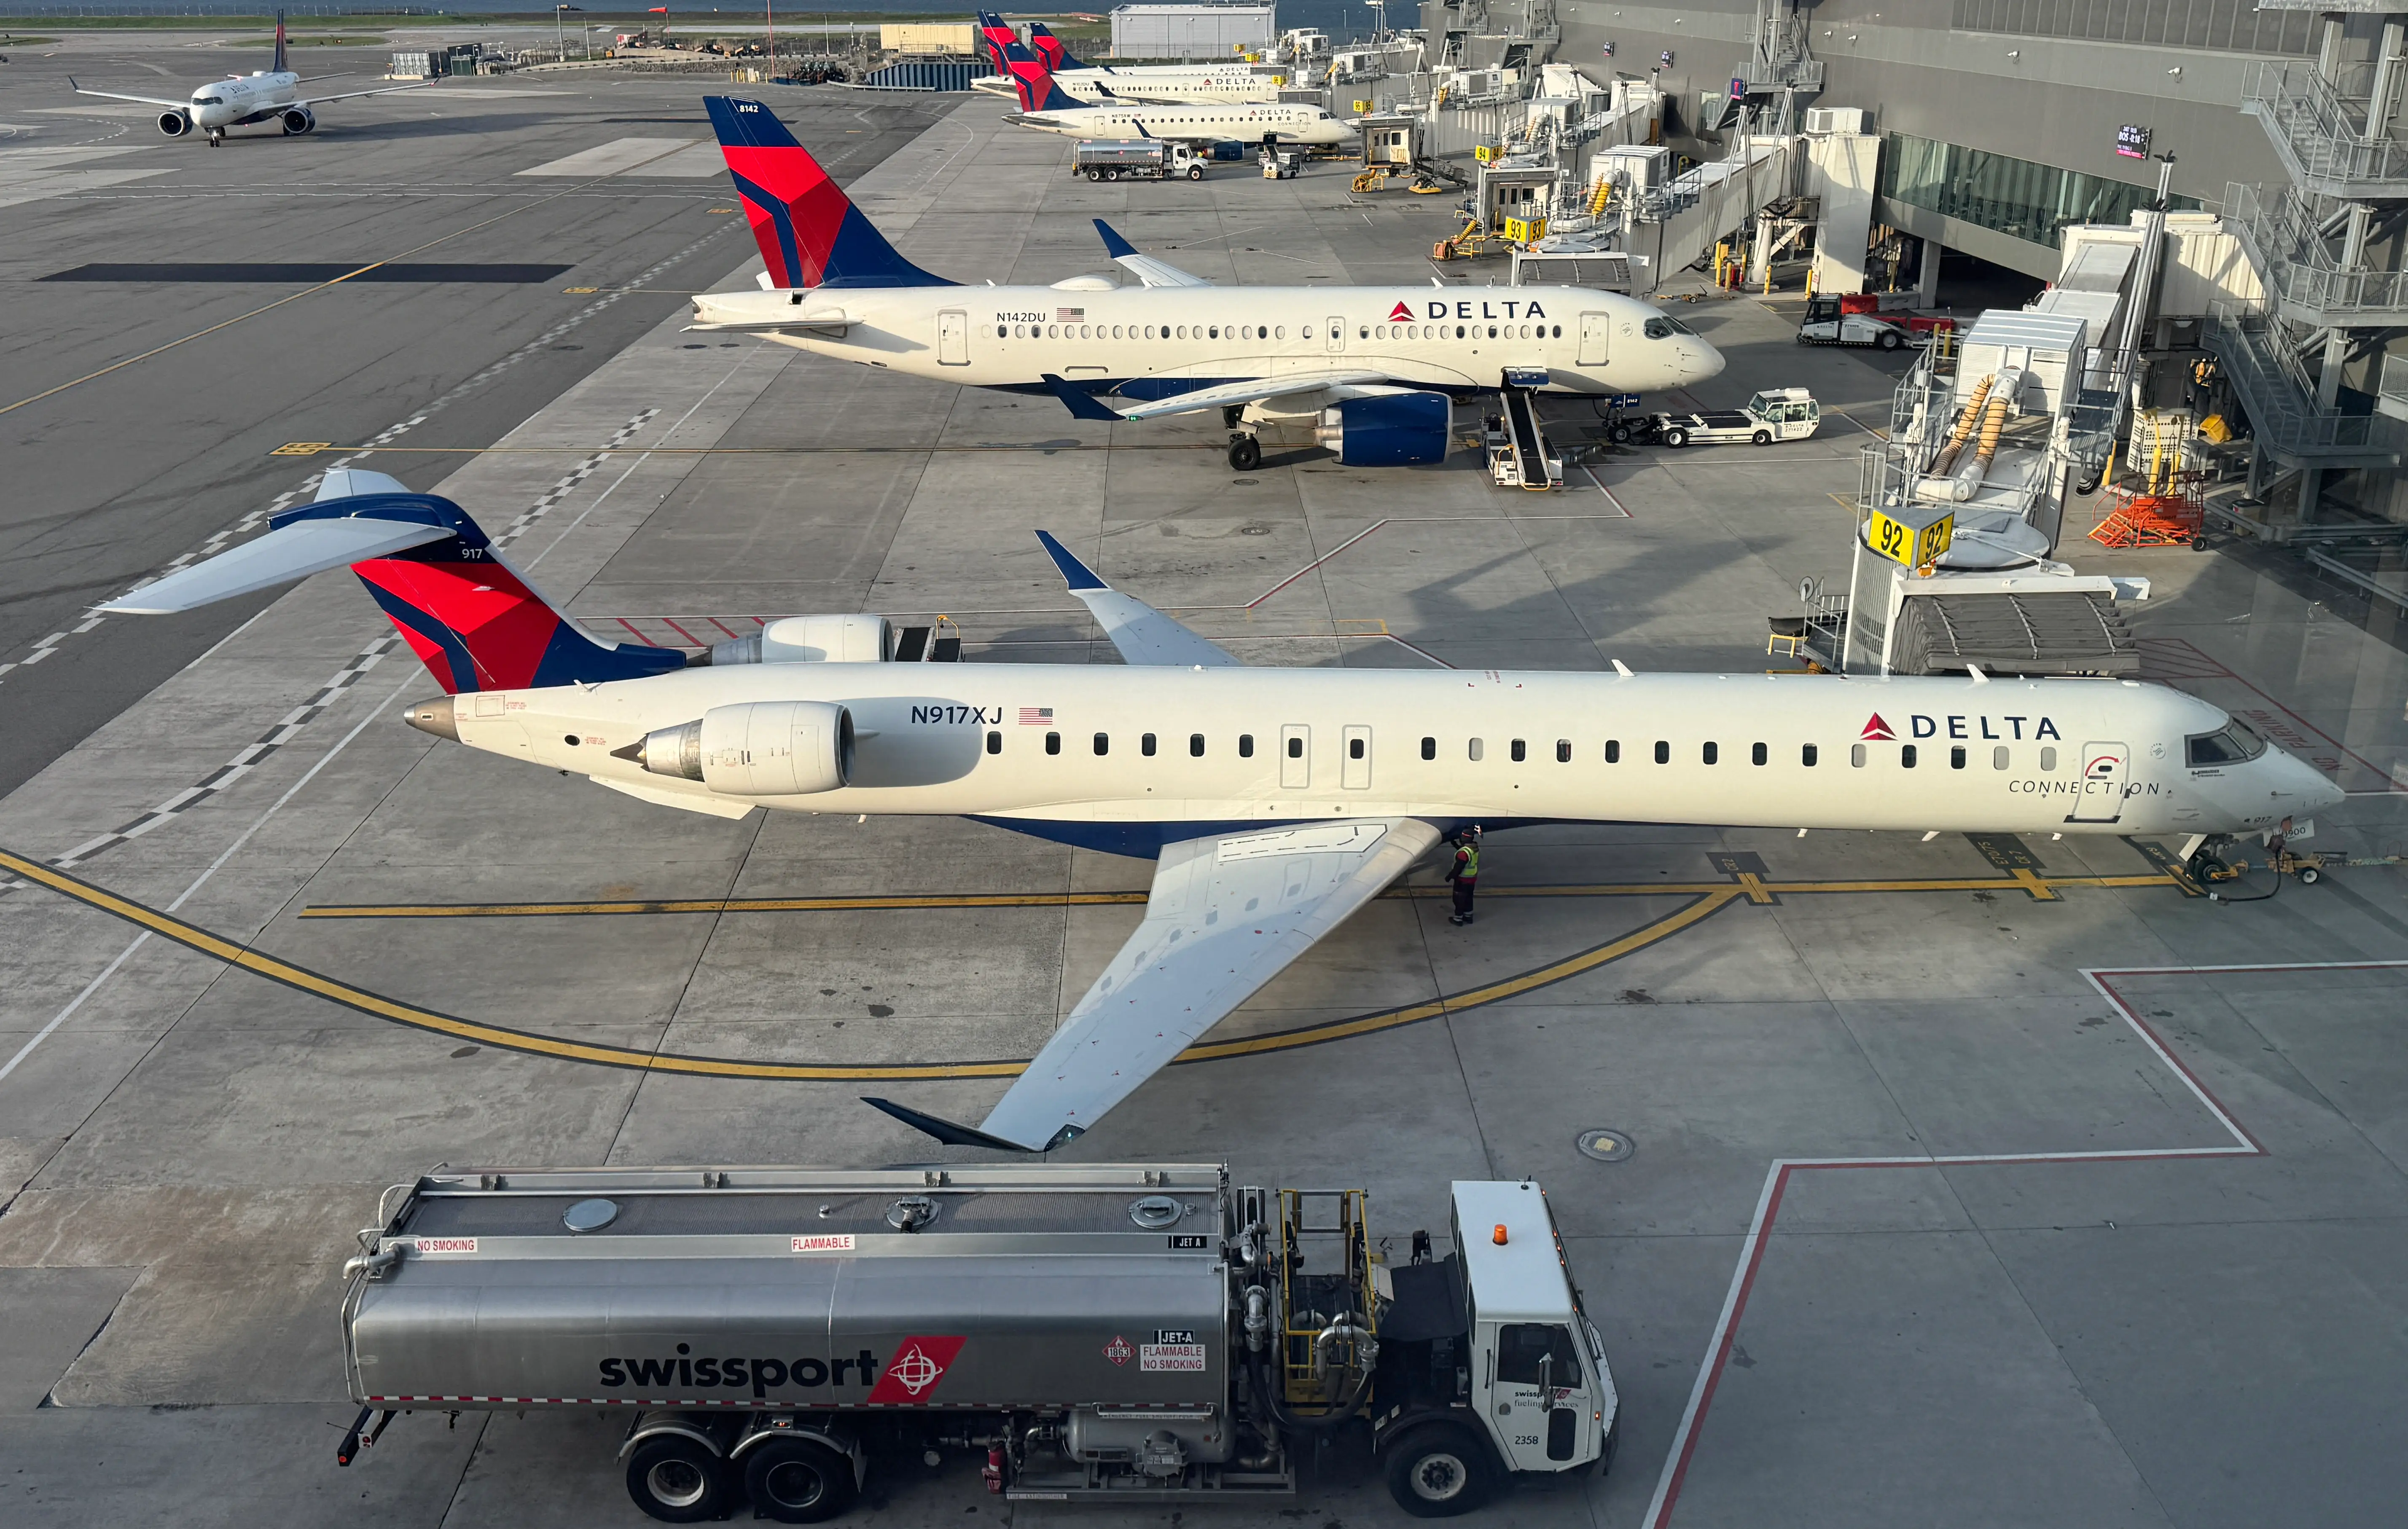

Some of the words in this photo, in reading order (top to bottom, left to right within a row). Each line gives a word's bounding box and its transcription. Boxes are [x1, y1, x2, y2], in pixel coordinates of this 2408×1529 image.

[2118, 131, 2129, 142] BOS
[1479, 148, 1486, 160] 94
[1493, 147, 1499, 160] 94
[1511, 220, 1521, 239] 93
[1533, 220, 1541, 240] 93
[1428, 301, 1546, 319] DELTA
[997, 312, 1045, 322] N142DU
[1881, 519, 1903, 558] 92
[1925, 523, 1943, 559] 92
[462, 549, 482, 558] 917
[911, 706, 1002, 724] N917XJ
[1911, 714, 2061, 740] DELTA
[2009, 780, 2161, 794] CONNECTION
[417, 1241, 430, 1251] NO
[433, 1240, 474, 1251] SMOKING
[793, 1237, 850, 1250] FLAMMABLE
[1179, 1237, 1193, 1247] JET
[1196, 1237, 1201, 1247] A
[1162, 1332, 1193, 1343] JET-A
[1110, 1348, 1129, 1357] 1863
[1144, 1346, 1202, 1356] FLAMMABLE
[1144, 1360, 1157, 1369] NO
[1160, 1360, 1202, 1369] SMOKING
[599, 1343, 878, 1398] swissport
[1515, 1390, 1543, 1399] swissp
[1515, 1399, 1543, 1409] fueling
[1515, 1435, 1539, 1445] 2358
